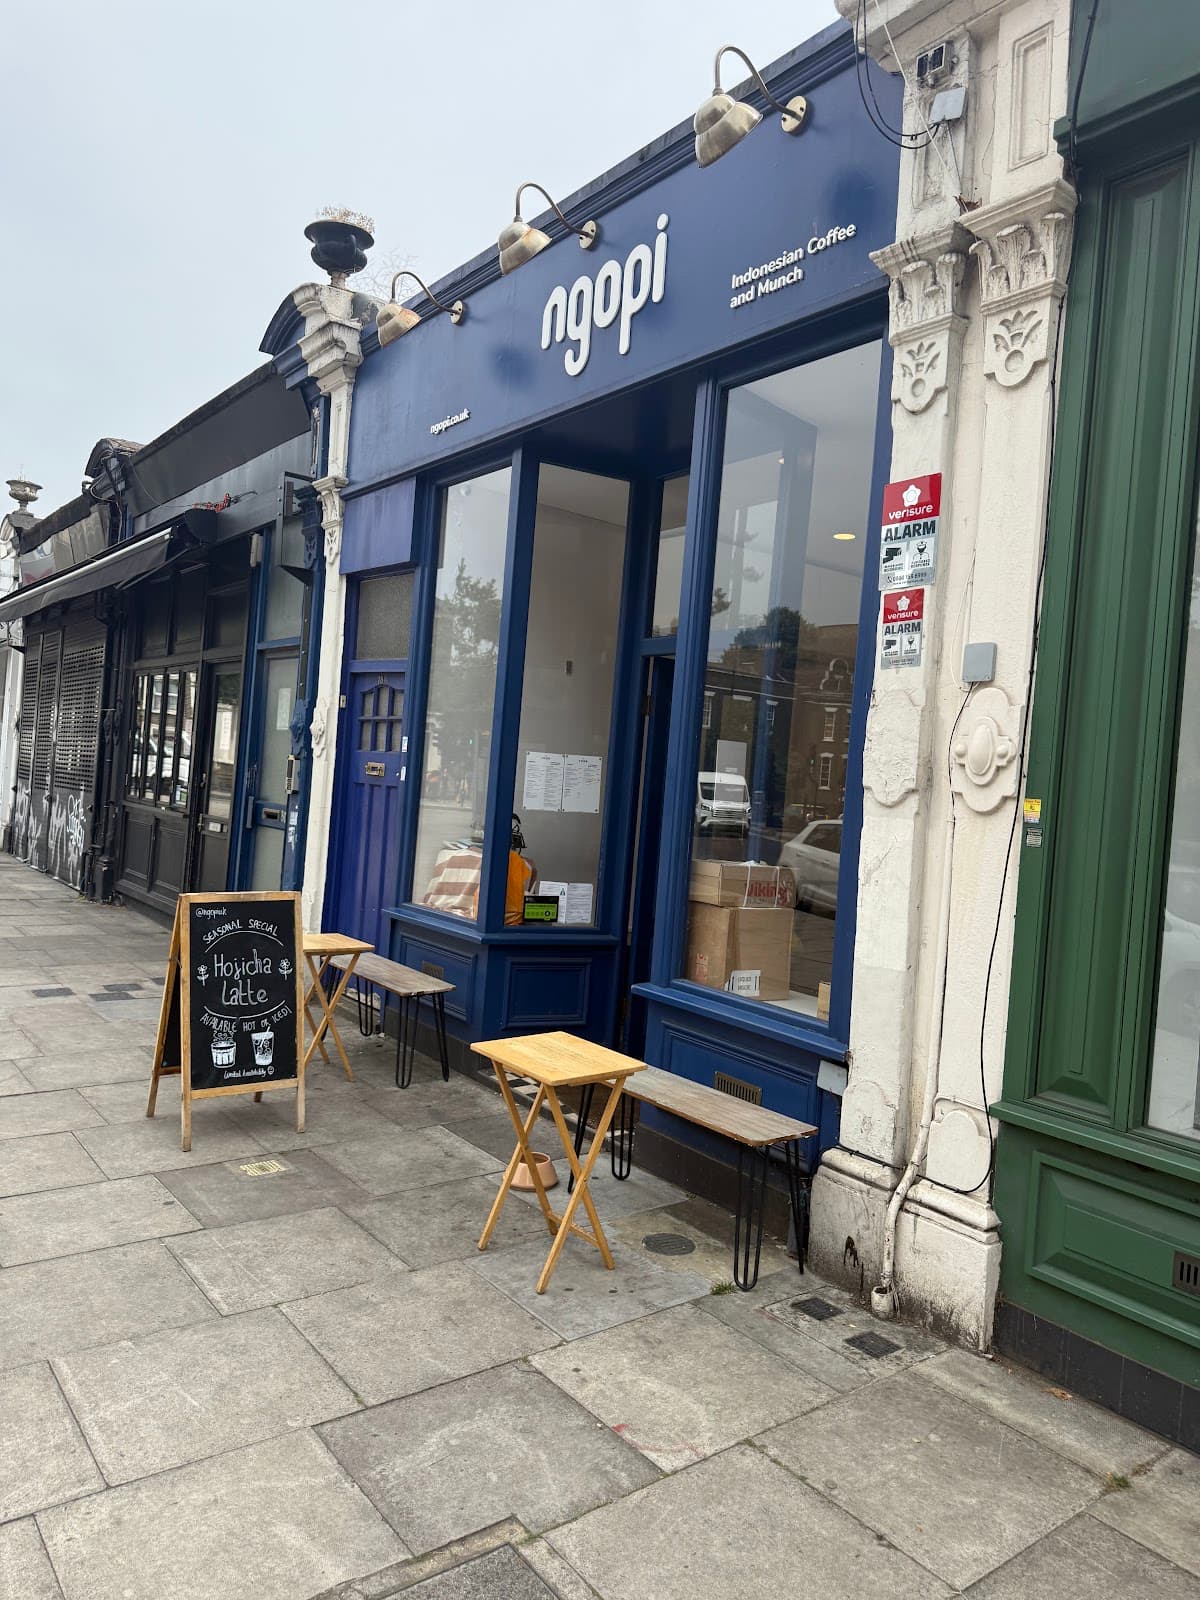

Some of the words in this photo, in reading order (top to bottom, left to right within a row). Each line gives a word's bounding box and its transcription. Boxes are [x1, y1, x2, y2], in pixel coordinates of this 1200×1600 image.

[731, 247, 804, 289] Indonesian
[807, 223, 857, 254] Coffee
[540, 213, 670, 377] ngopi
[730, 285, 755, 308] and
[757, 266, 804, 297] Munch
[430, 408, 470, 435] ngopi.co.uk
[888, 504, 934, 520] verisure
[884, 520, 936, 542] ALARM
[887, 610, 919, 621] verisure
[884, 622, 921, 636] ALARM
[202, 919, 243, 944] SEASONAL
[248, 918, 278, 937] SPECIAL
[213, 948, 272, 980] Hojicha
[199, 1012, 238, 1033] AVAILABLE
[242, 1021, 256, 1032] HOT
[260, 1018, 272, 1028] OR
